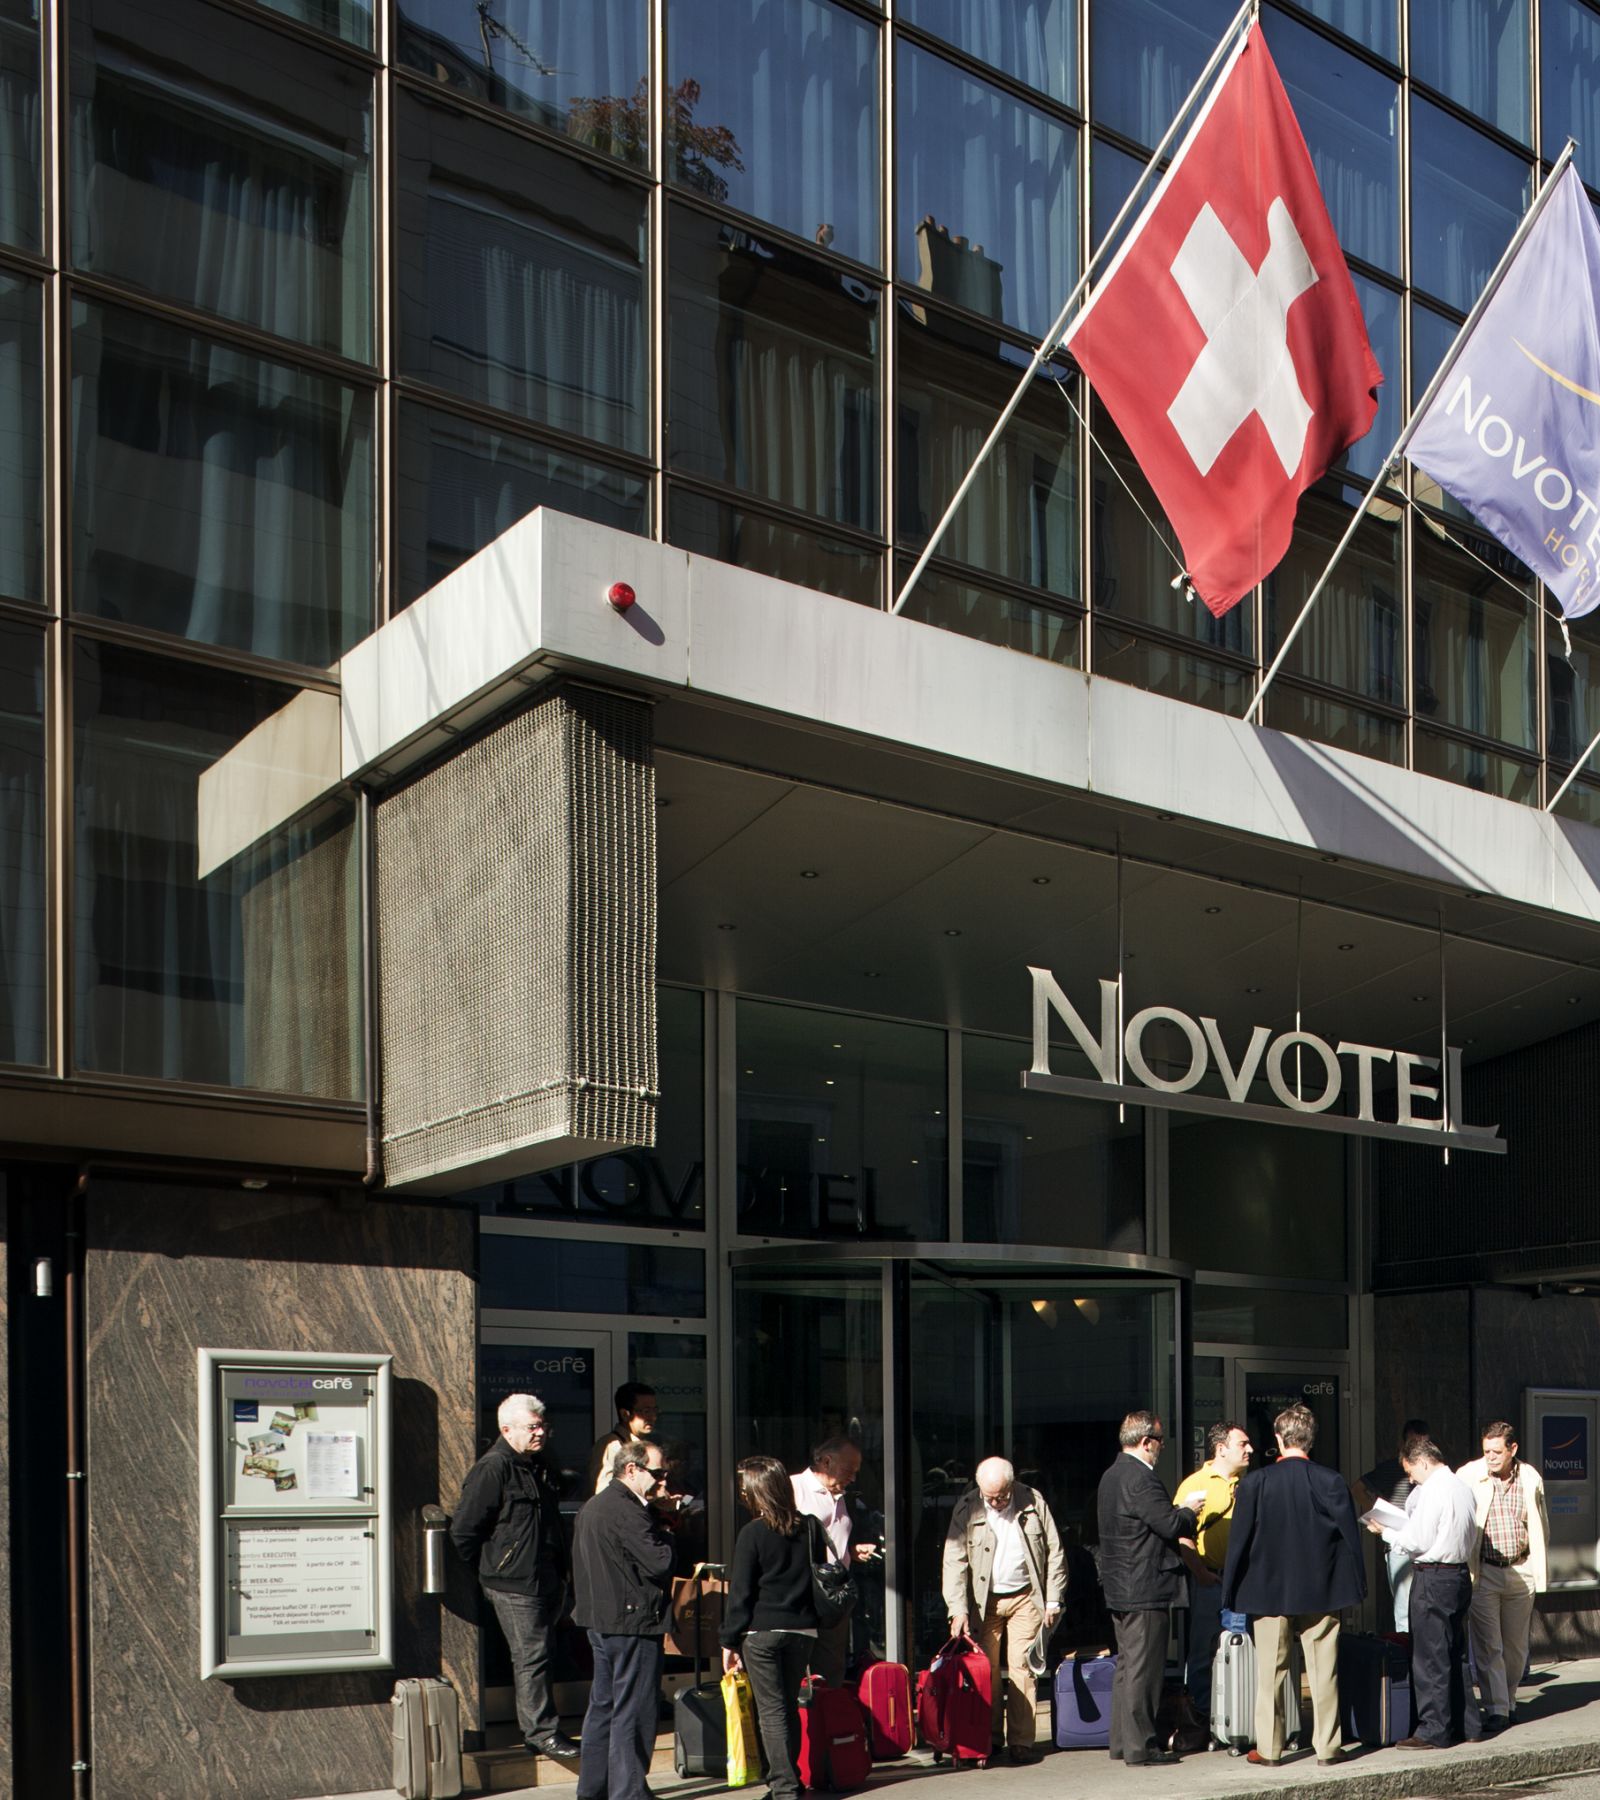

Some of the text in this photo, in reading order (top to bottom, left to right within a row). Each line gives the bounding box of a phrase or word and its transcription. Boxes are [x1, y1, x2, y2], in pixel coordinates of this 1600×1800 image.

[1027, 966, 1500, 1138] NOVOTEL
[533, 1356, 586, 1374] café
[1302, 1382, 1335, 1396] café
[1545, 1459, 1585, 1470] NOVOTEL
